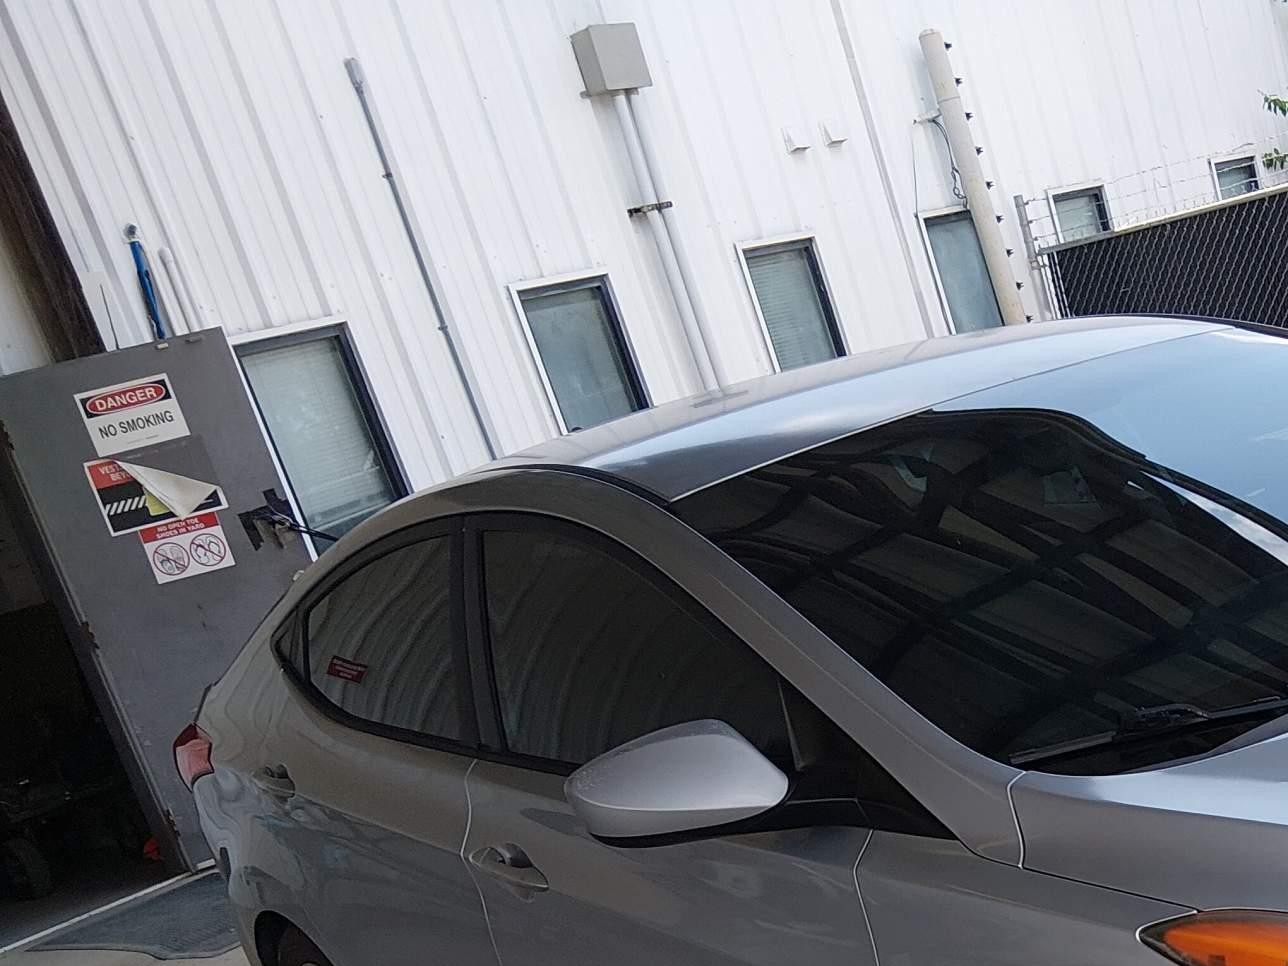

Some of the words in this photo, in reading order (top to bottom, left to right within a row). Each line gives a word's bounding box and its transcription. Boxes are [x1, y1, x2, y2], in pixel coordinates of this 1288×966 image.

[95, 387, 157, 411] DANGER
[98, 424, 117, 439] NO
[119, 410, 174, 434] SMOKING
